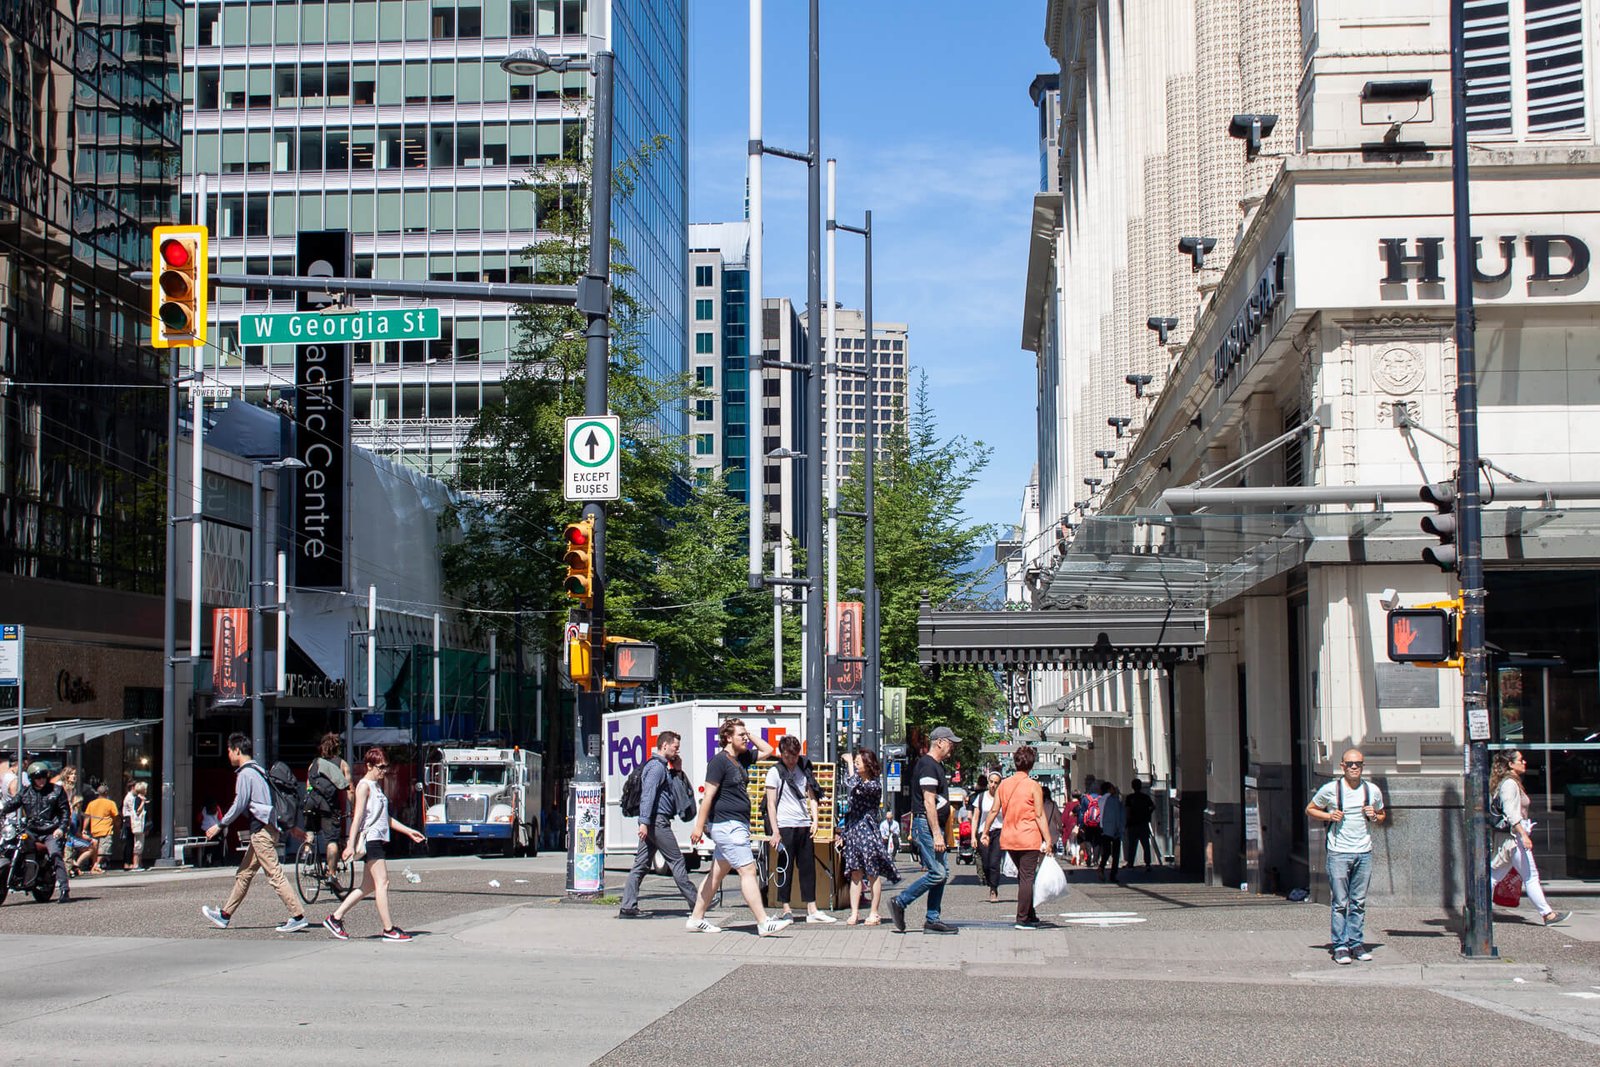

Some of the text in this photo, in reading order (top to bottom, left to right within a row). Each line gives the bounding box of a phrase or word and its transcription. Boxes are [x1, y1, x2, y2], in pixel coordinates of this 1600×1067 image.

[254, 311, 425, 339] W Georgia St
[193, 389, 214, 397] POWER
[304, 345, 332, 558] acific Centre
[573, 472, 610, 482] EXCEPT
[576, 484, 609, 494] BUSES
[607, 714, 659, 777] FedE
